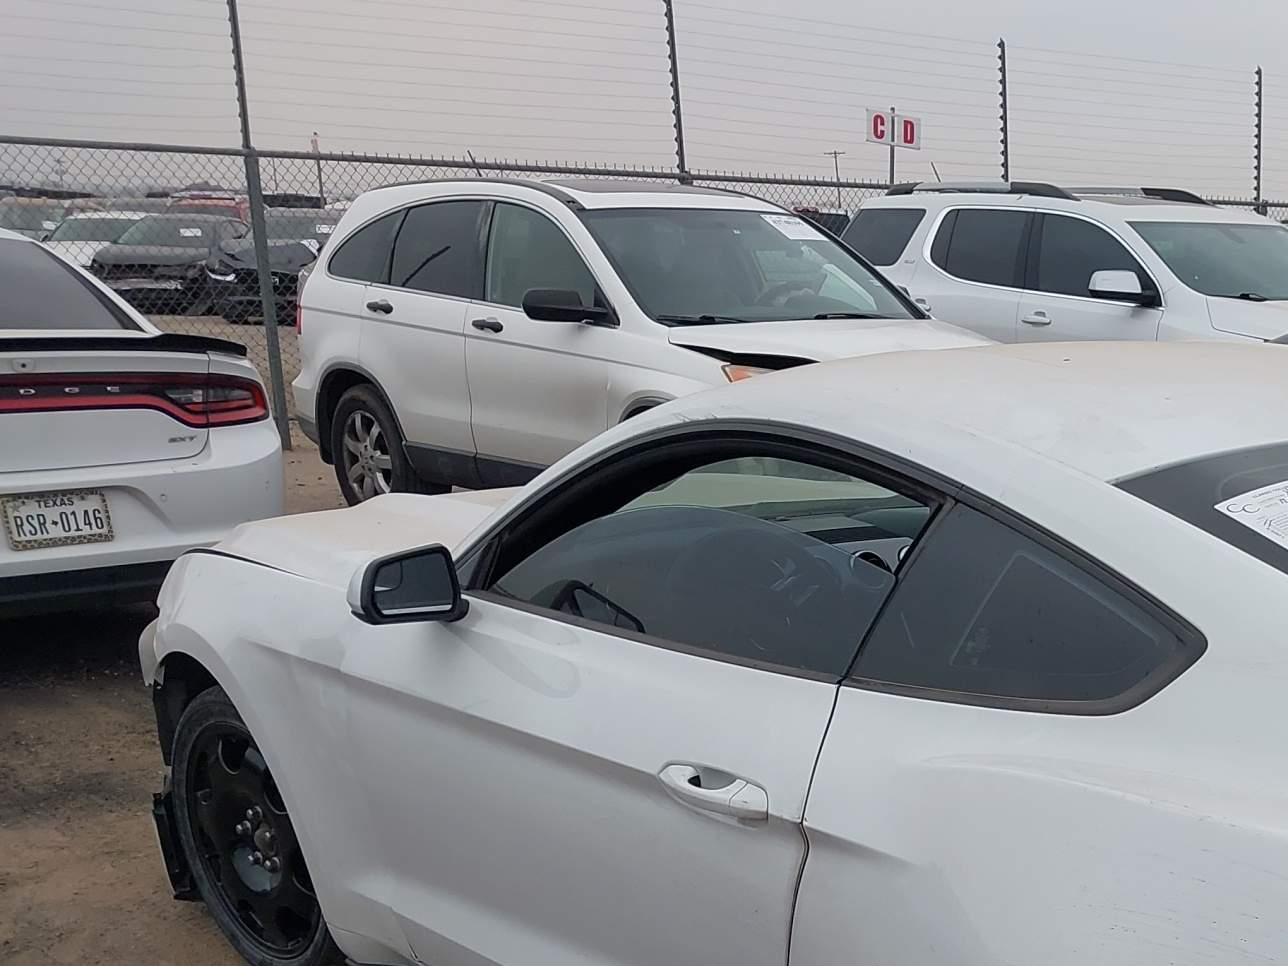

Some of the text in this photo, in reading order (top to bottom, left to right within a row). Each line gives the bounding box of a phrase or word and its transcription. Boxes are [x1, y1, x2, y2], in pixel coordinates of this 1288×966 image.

[873, 114, 915, 145] C D
[36, 496, 75, 509] TEXAS
